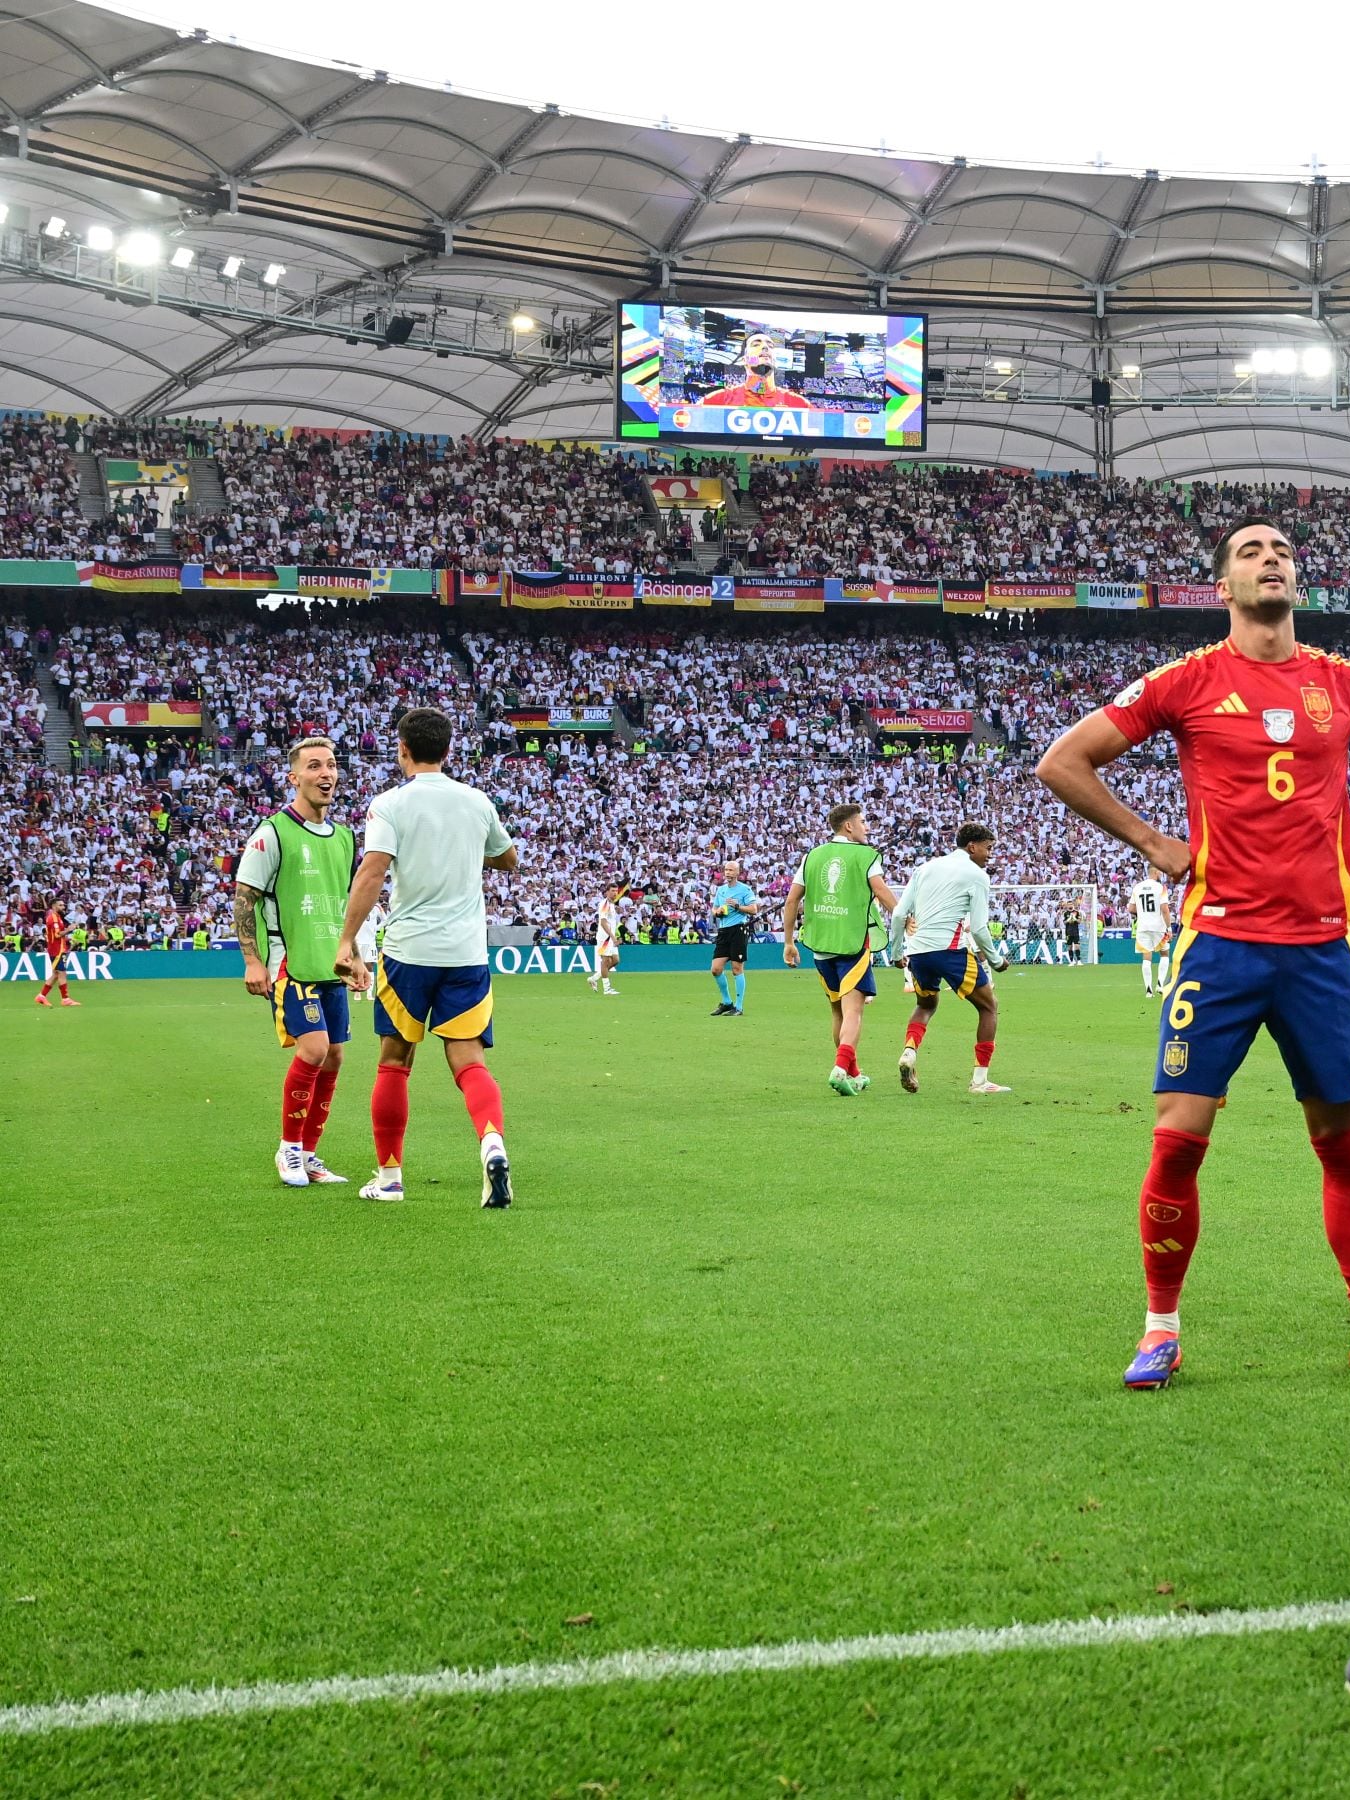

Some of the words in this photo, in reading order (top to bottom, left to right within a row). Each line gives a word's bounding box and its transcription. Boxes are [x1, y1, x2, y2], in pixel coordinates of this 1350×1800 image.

[727, 409, 825, 438] GOAL
[299, 574, 371, 591] RIEDLINGEN
[568, 573, 628, 583] BIERFRONT
[742, 578, 817, 587] NATIONALMANNSCHAFT
[642, 579, 712, 604] Bösingen
[760, 590, 796, 598] SUPPORTER
[946, 592, 982, 602] WELZOW
[993, 585, 1072, 597] Seestermühe
[1089, 585, 1136, 599] MONNEM
[568, 599, 627, 608] NEURUPPIN
[584, 710, 610, 720] BURG
[921, 714, 967, 727] SENZIG
[1267, 751, 1296, 801] 6
[1139, 893, 1155, 912] 16
[996, 939, 1074, 965] ATAR
[290, 981, 320, 1001] 12
[1169, 980, 1200, 1030] 6
